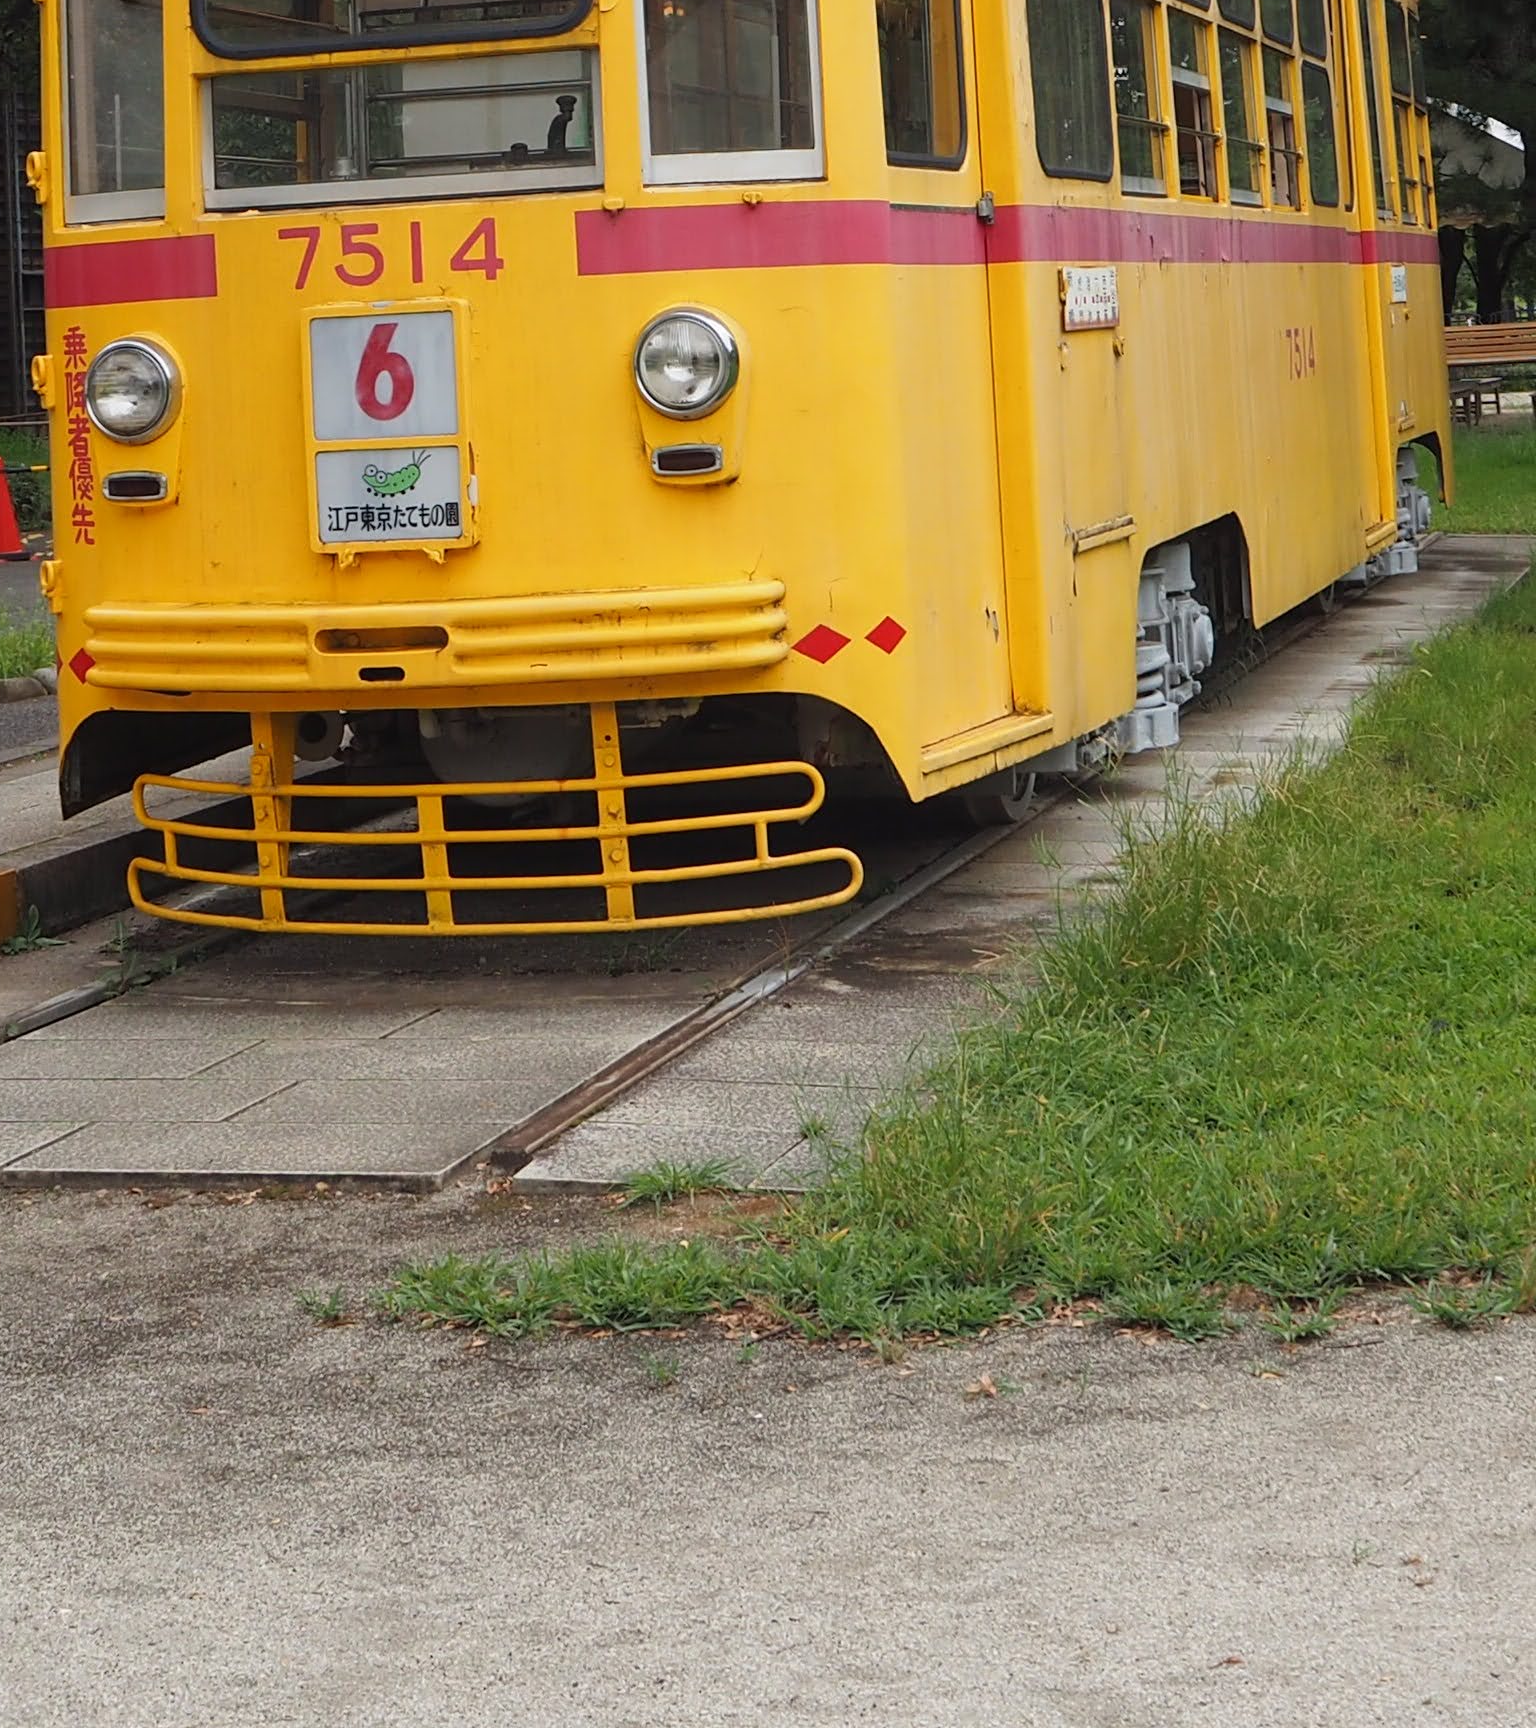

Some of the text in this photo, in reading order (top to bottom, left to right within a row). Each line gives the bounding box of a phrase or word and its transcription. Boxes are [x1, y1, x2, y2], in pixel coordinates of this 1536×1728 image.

[277, 216, 505, 291] 7514
[354, 320, 415, 422] 6
[1285, 325, 1316, 381] 7514
[62, 325, 96, 546] 乗降者優先
[327, 501, 460, 533] 江戸東京たてもの園
